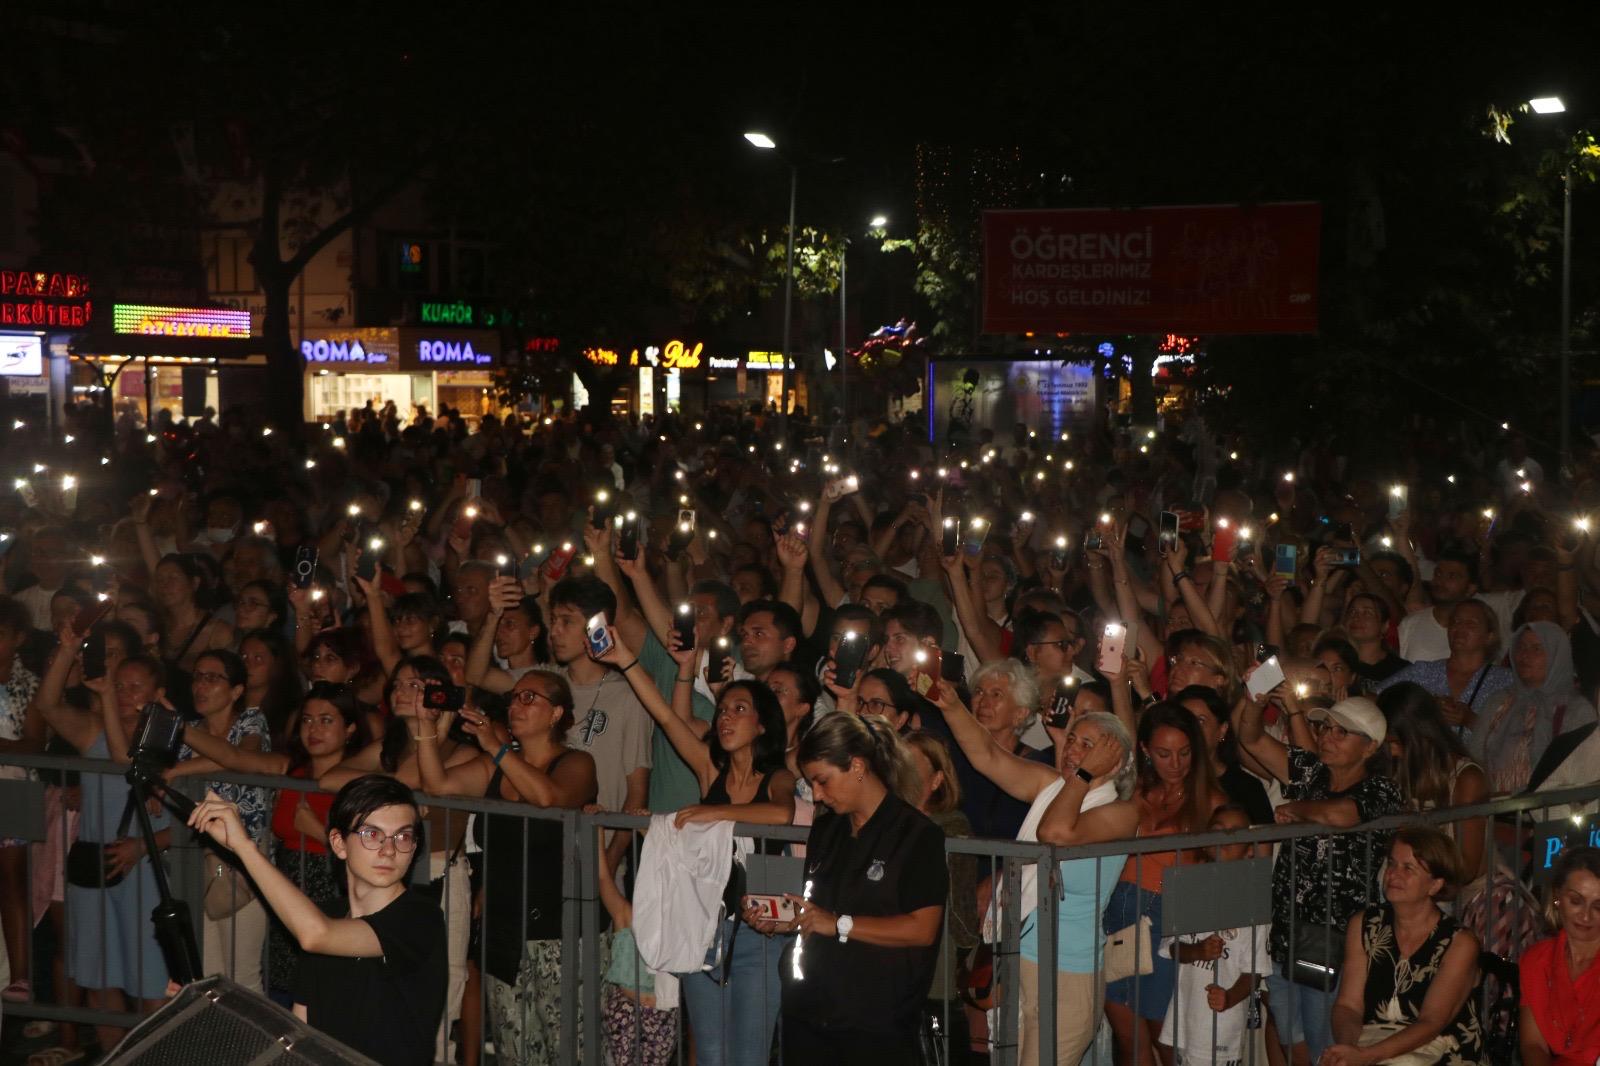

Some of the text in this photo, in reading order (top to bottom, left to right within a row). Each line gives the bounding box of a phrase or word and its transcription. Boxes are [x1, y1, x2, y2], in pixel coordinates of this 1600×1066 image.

[1009, 226, 1152, 260] ÖĞRENCİ
[1011, 262, 1151, 282] KARDEŞLERİMİZ
[1010, 288, 1150, 308] HOŞ GELDİNİZ!
[421, 301, 473, 323] KUAFÖR
[301, 340, 365, 361] ROMA
[420, 340, 474, 361] ROMA
